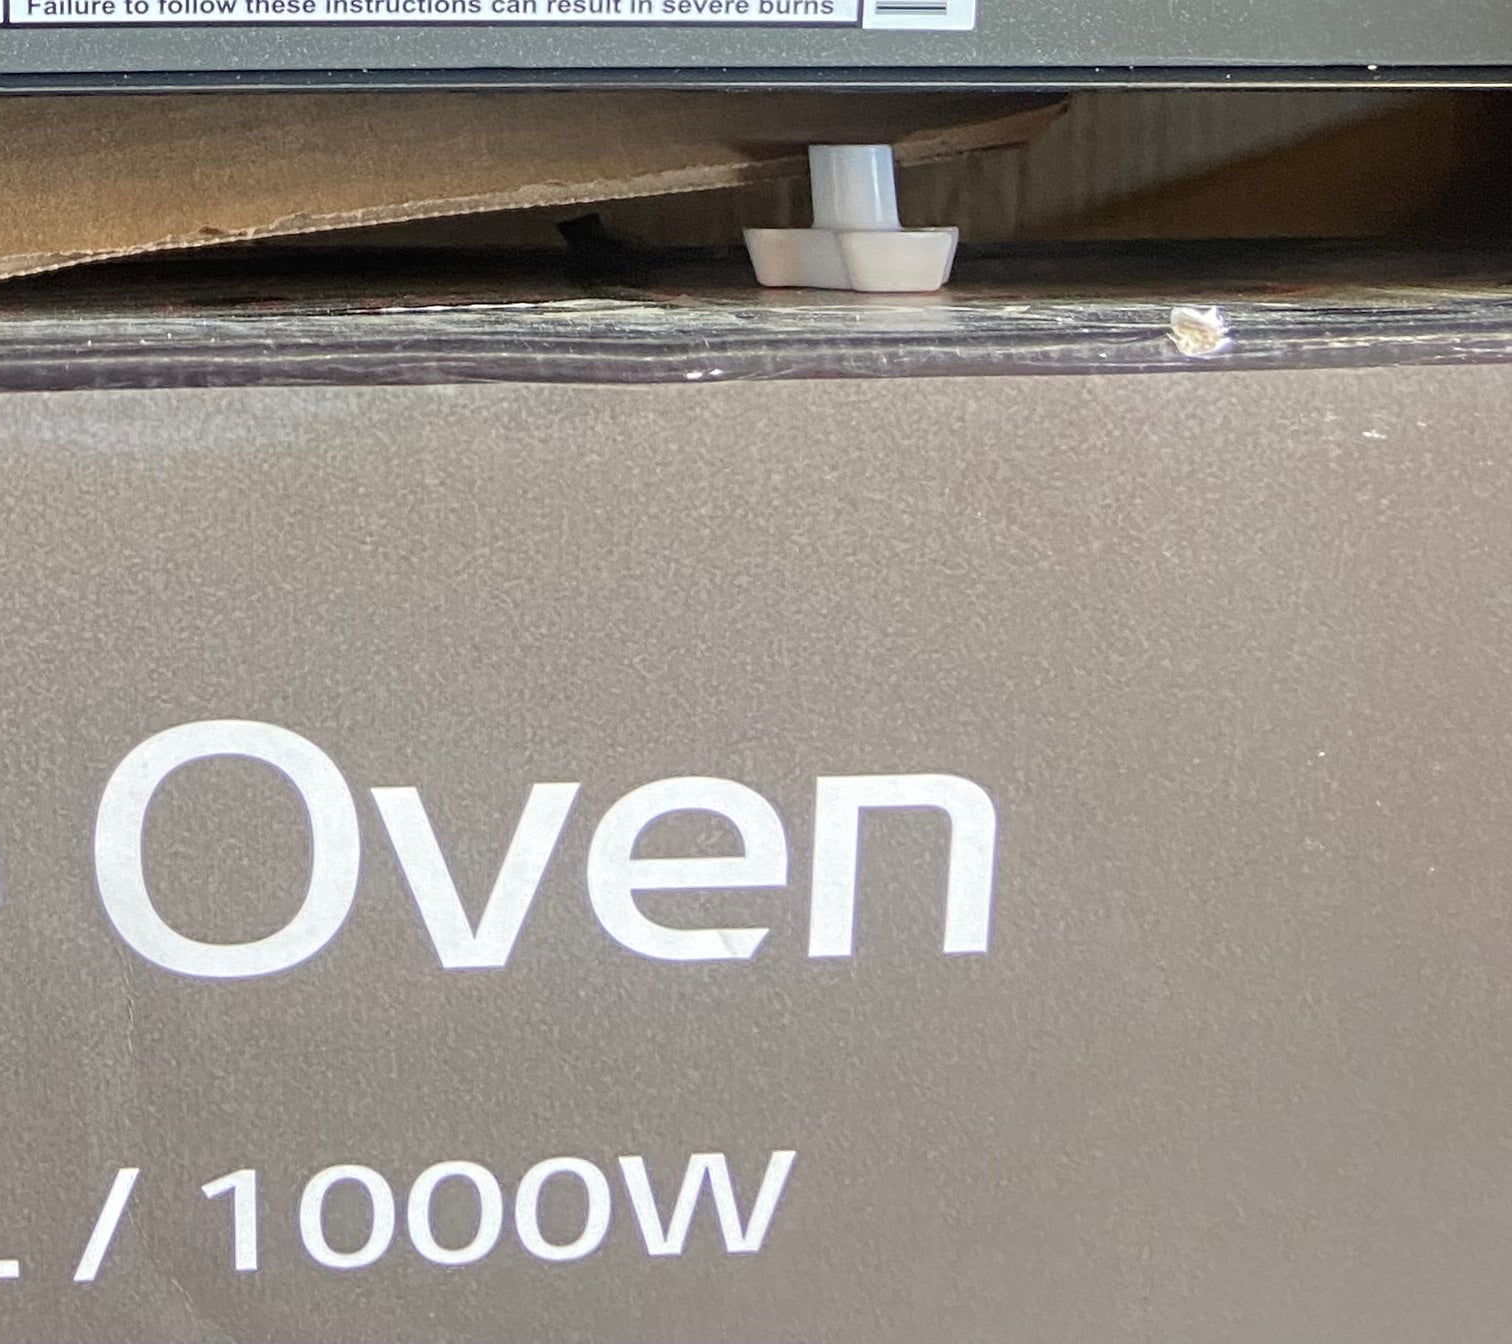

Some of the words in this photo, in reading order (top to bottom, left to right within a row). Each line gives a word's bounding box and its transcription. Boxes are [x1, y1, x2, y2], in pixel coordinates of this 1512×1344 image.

[124, 0, 149, 15] to
[491, 0, 538, 14] can
[662, 0, 750, 14] severe
[94, 719, 996, 978] Oven
[73, 1167, 139, 1282] /
[201, 1150, 796, 1272] 1000W
